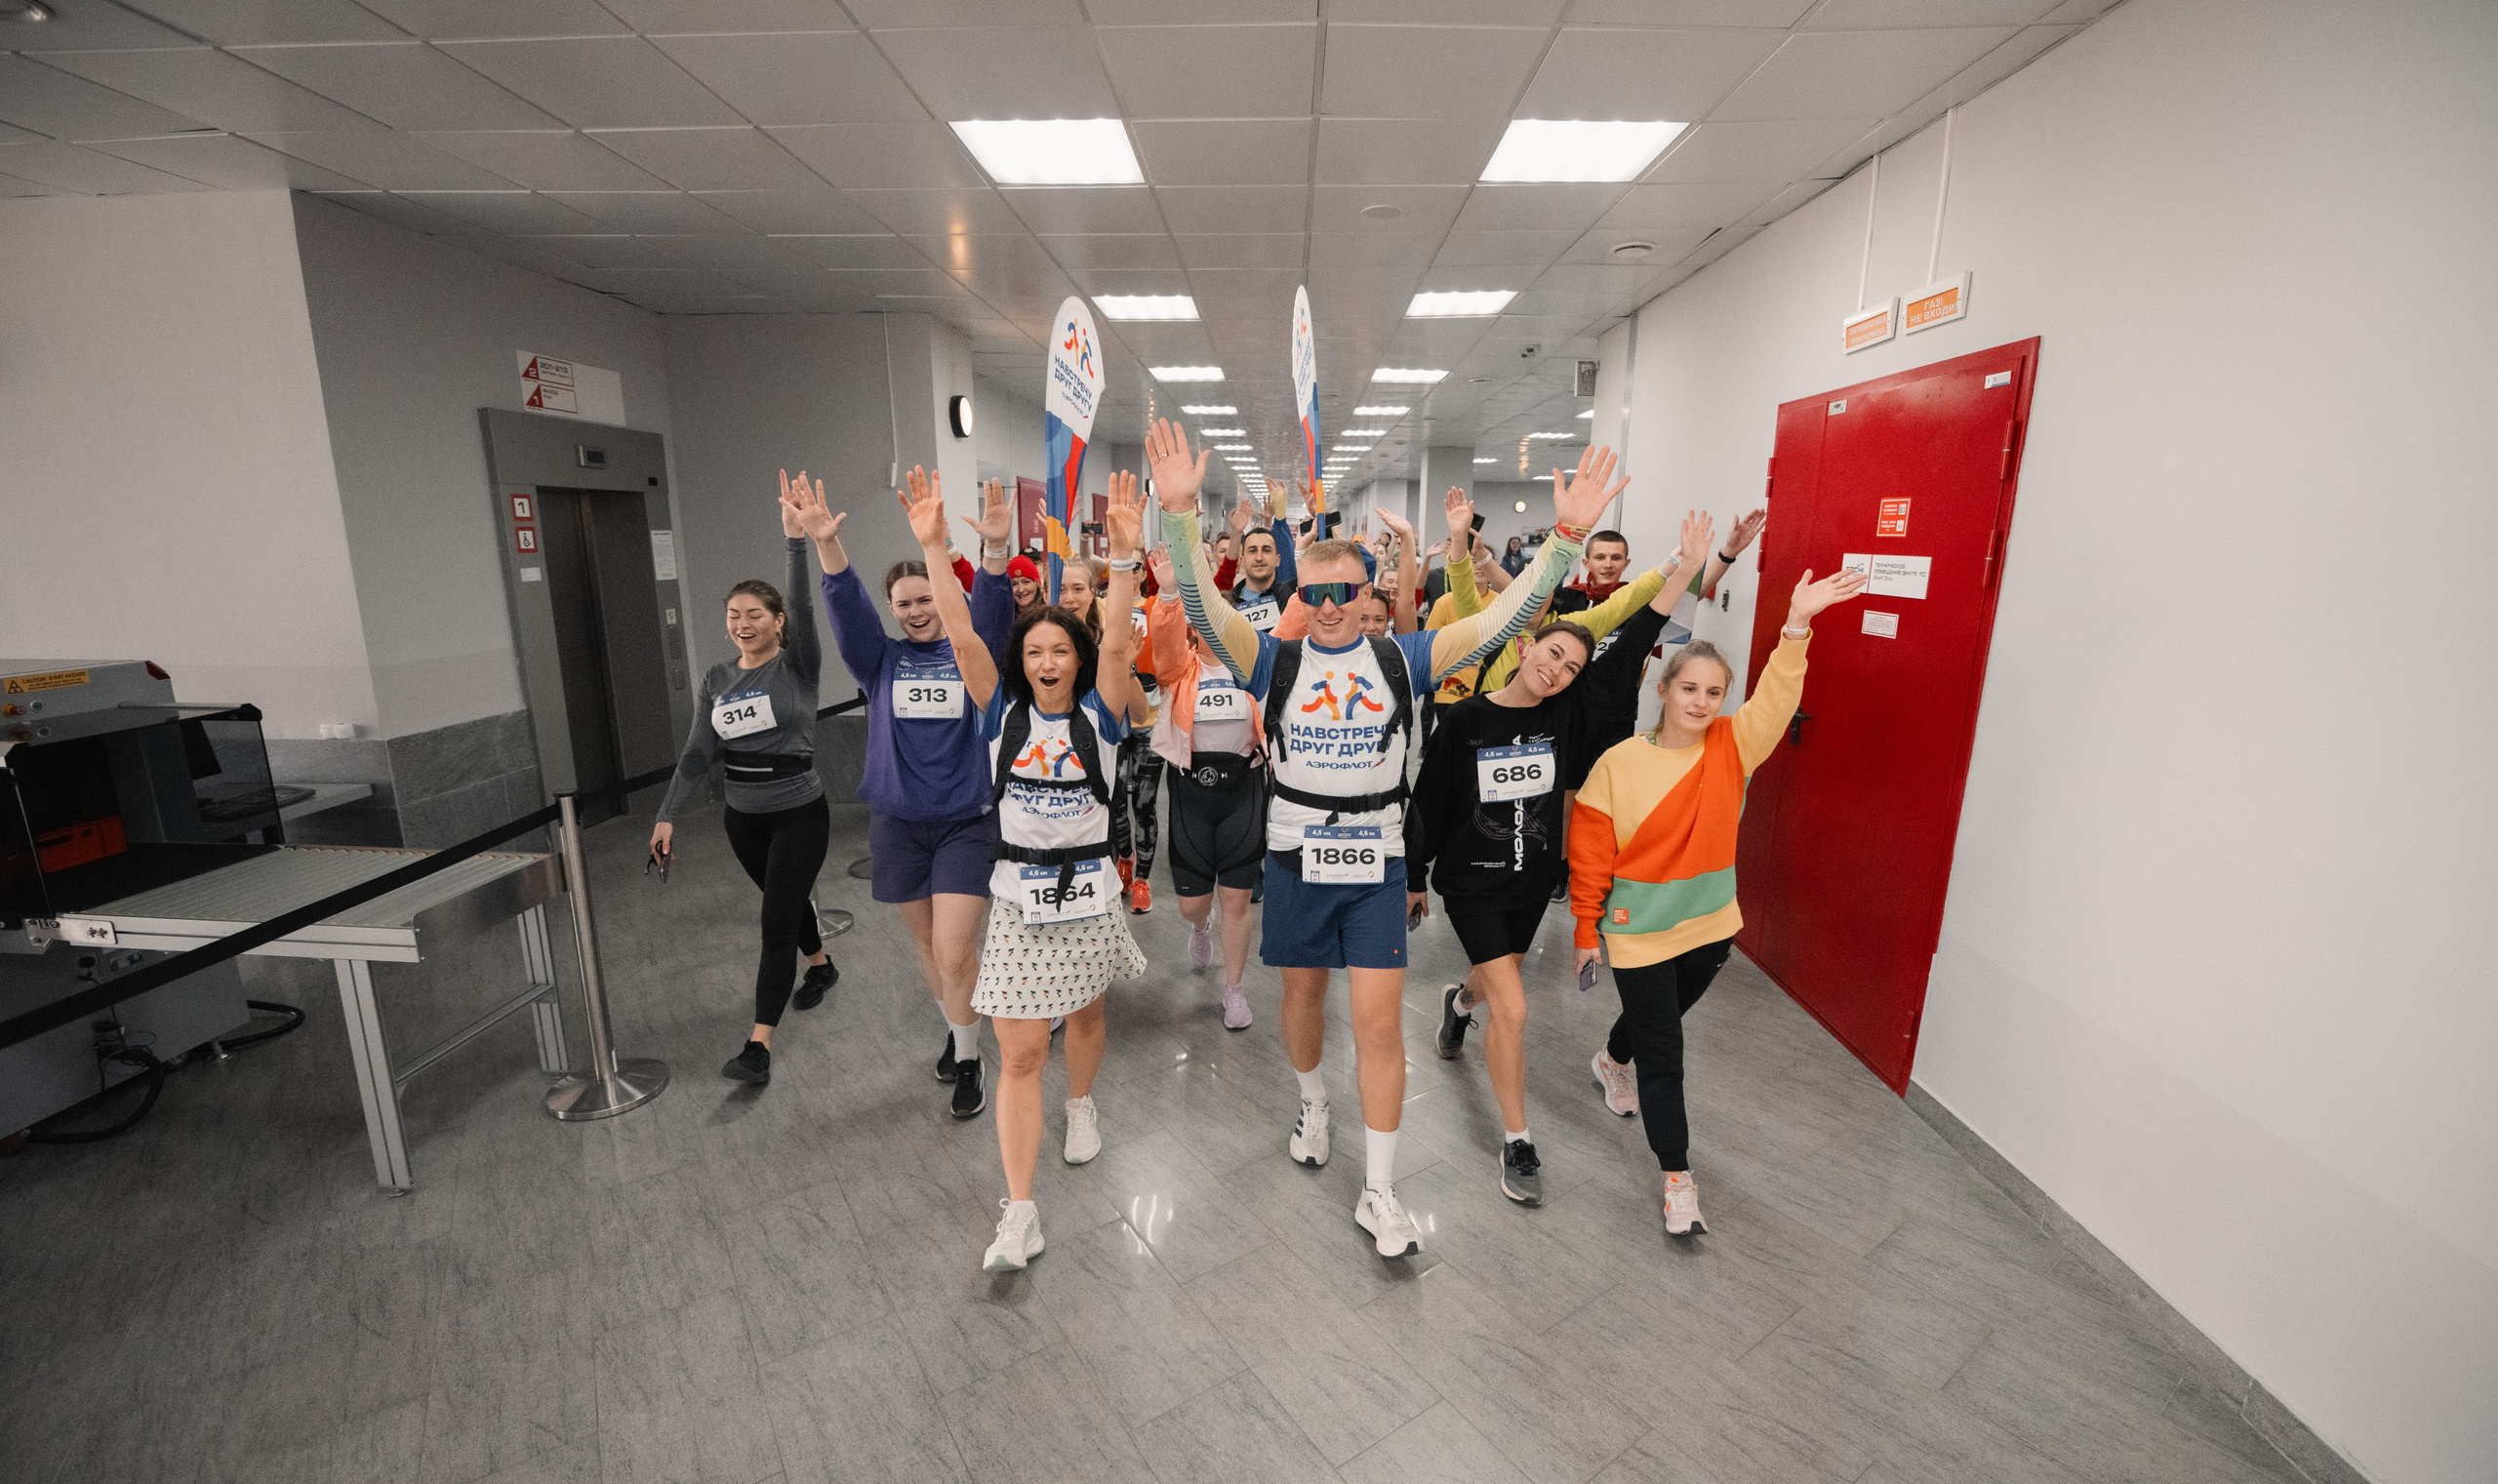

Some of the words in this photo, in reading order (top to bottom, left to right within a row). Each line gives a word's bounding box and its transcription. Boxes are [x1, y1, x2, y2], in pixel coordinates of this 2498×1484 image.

[1924, 297, 1944, 311] ГАЗ!
[1911, 312, 1922, 325] НЕ
[1923, 303, 1957, 321] ВХОДИ!
[1850, 315, 1887, 336] АВТОМАТИКА
[1850, 328, 1886, 345] ОТКЛЮЧЕНА
[529, 367, 538, 378] 2
[1055, 354, 1092, 400] НАВСТРЕЧУ
[1054, 368, 1072, 390] ДРУГ
[1072, 385, 1092, 412] ДРУГУ
[532, 395, 540, 405] 1
[517, 501, 525, 514] 1
[1245, 609, 1269, 622] 127
[908, 688, 947, 702] 313
[1199, 694, 1233, 707] 491
[723, 705, 757, 725] 314
[1290, 723, 1387, 741] НАВСТРЕЧ
[1290, 739, 1334, 755] ДРУГ
[1306, 761, 1373, 770] АЭРОФЛОТ
[1492, 764, 1542, 783] 686
[1048, 792, 1090, 808] ДРУГ
[1311, 848, 1376, 864] 1866
[1030, 882, 1096, 904] 1864
